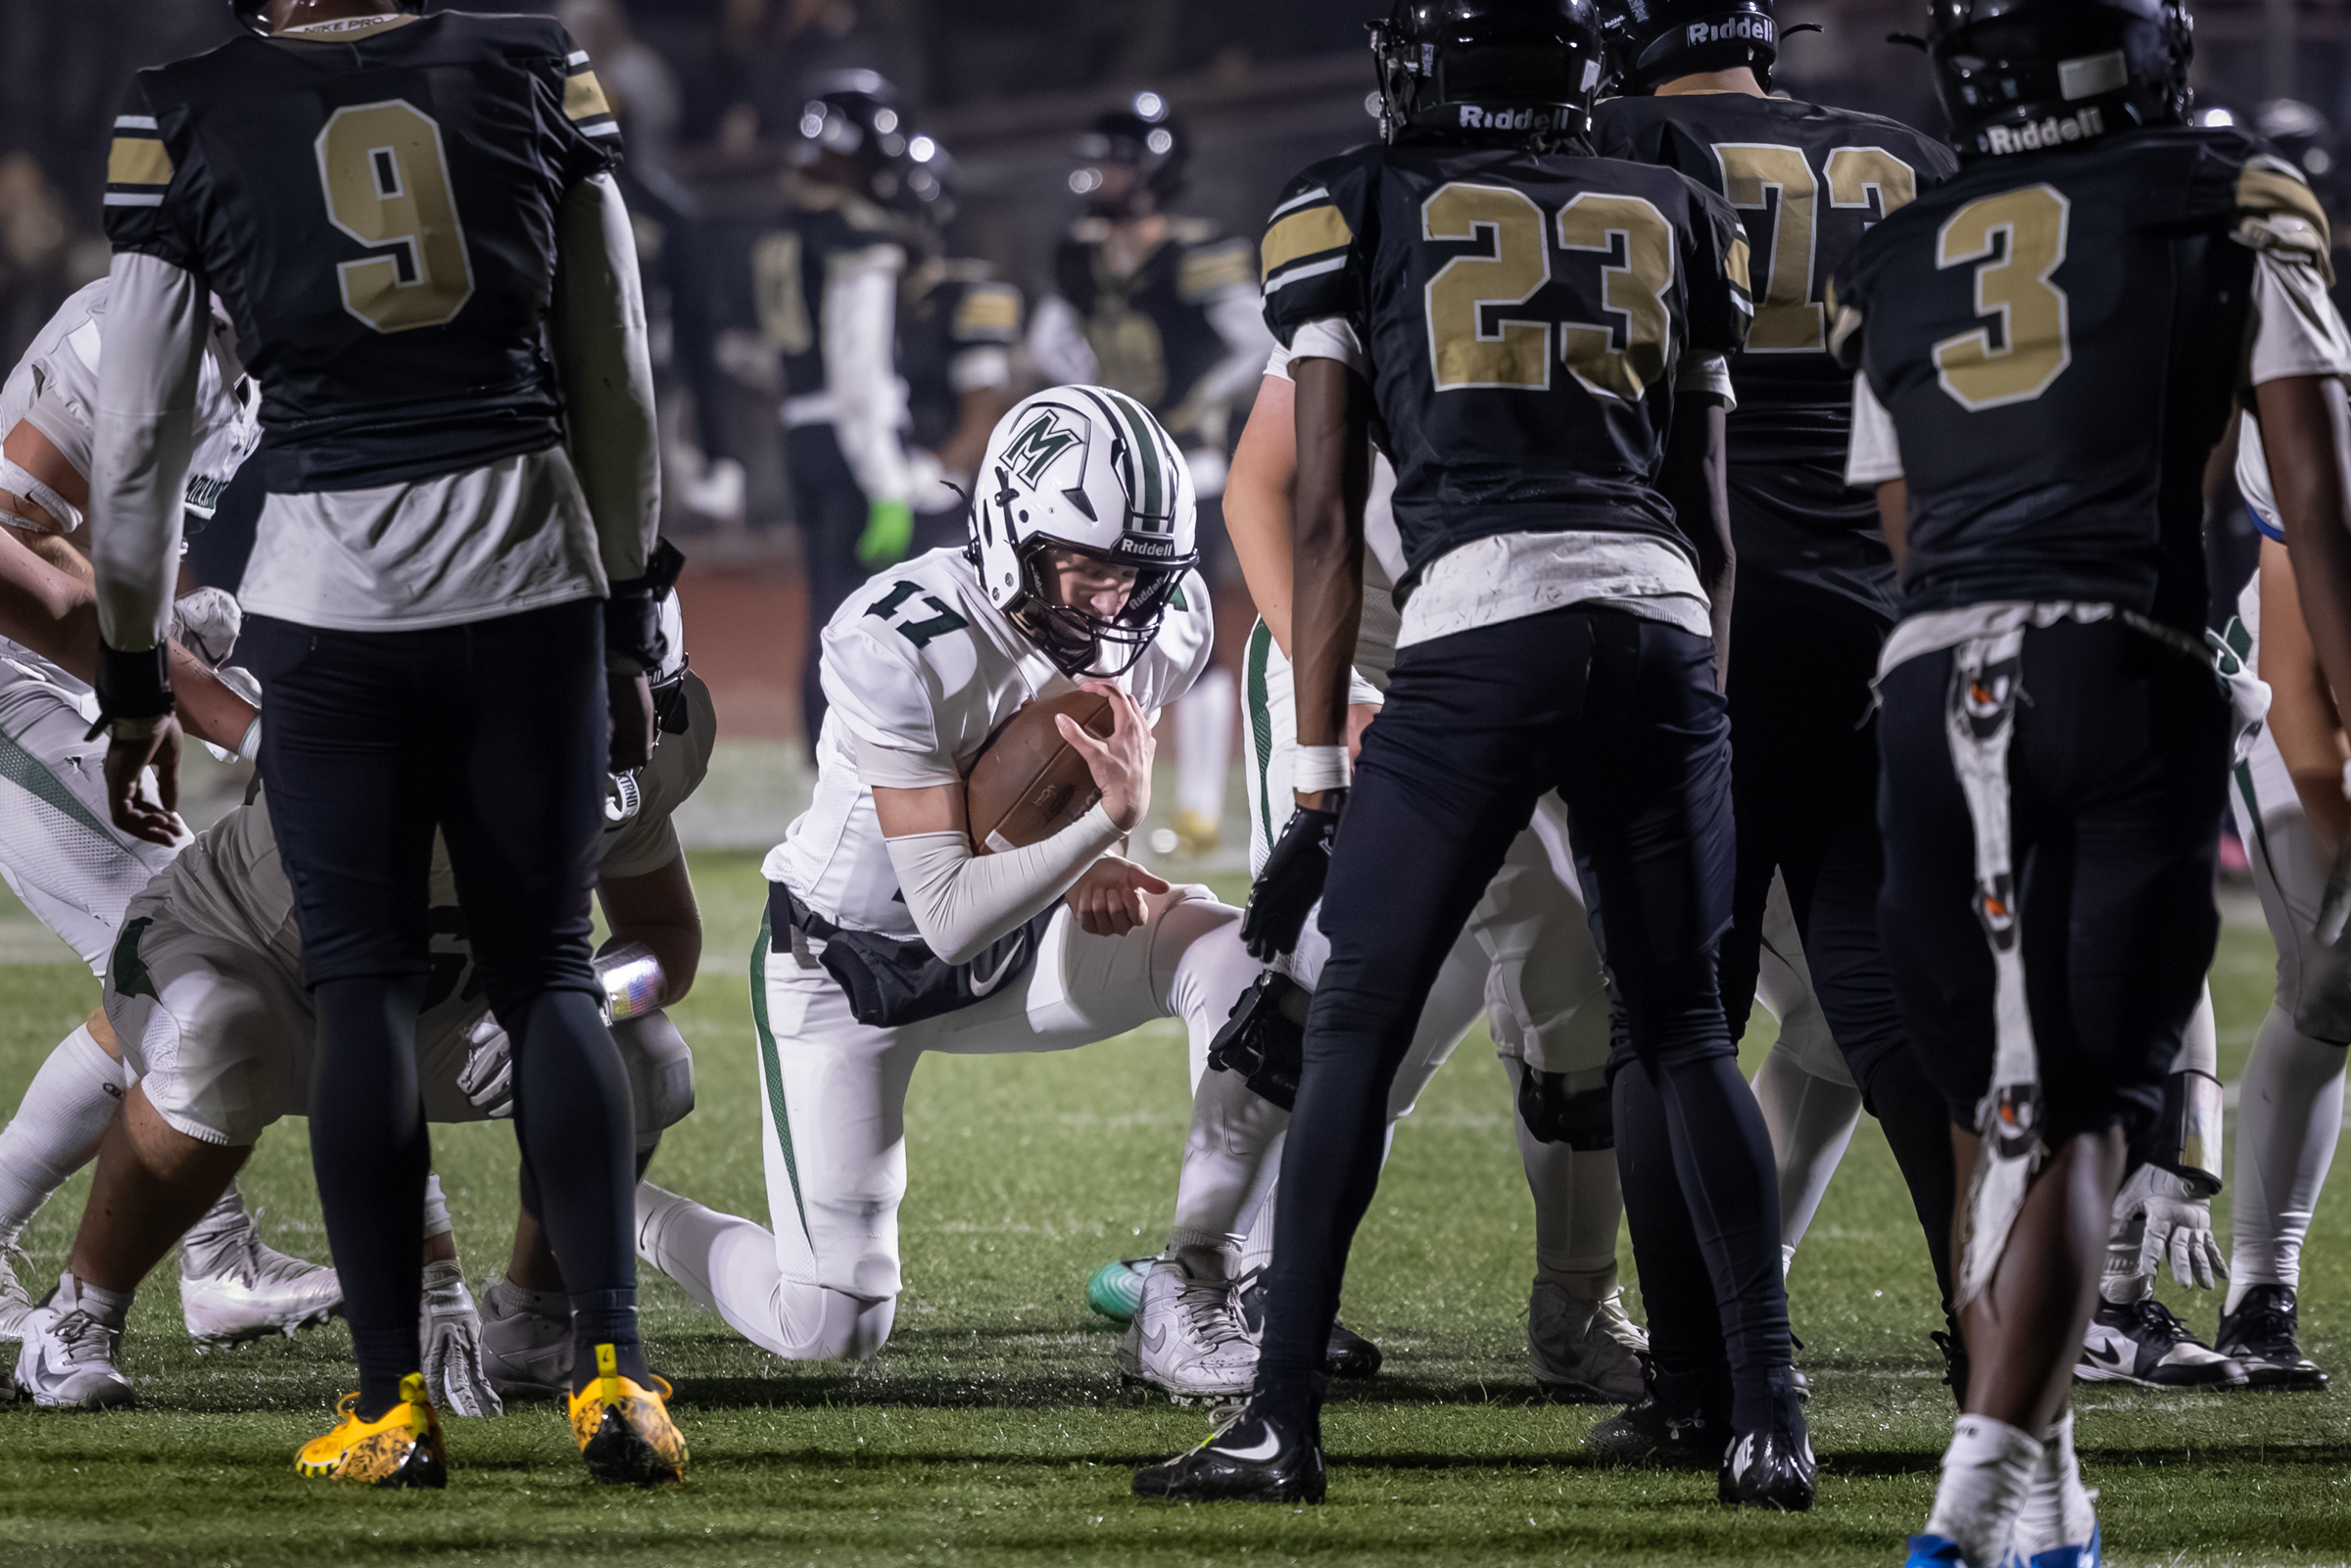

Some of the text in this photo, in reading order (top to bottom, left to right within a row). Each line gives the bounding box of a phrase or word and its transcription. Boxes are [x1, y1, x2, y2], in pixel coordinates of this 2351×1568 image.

[348, 17, 385, 29] PRO
[1689, 17, 1772, 43] Riddell
[1459, 105, 1569, 129] Riddell
[1986, 106, 2104, 155] Riddell
[313, 99, 475, 334] 9
[1421, 181, 1675, 403] 23
[1931, 182, 2072, 411] 3
[998, 408, 1083, 492] M
[1121, 538, 1173, 557] Riddell
[862, 580, 970, 650] 17
[1128, 576, 1164, 610] Riddell
